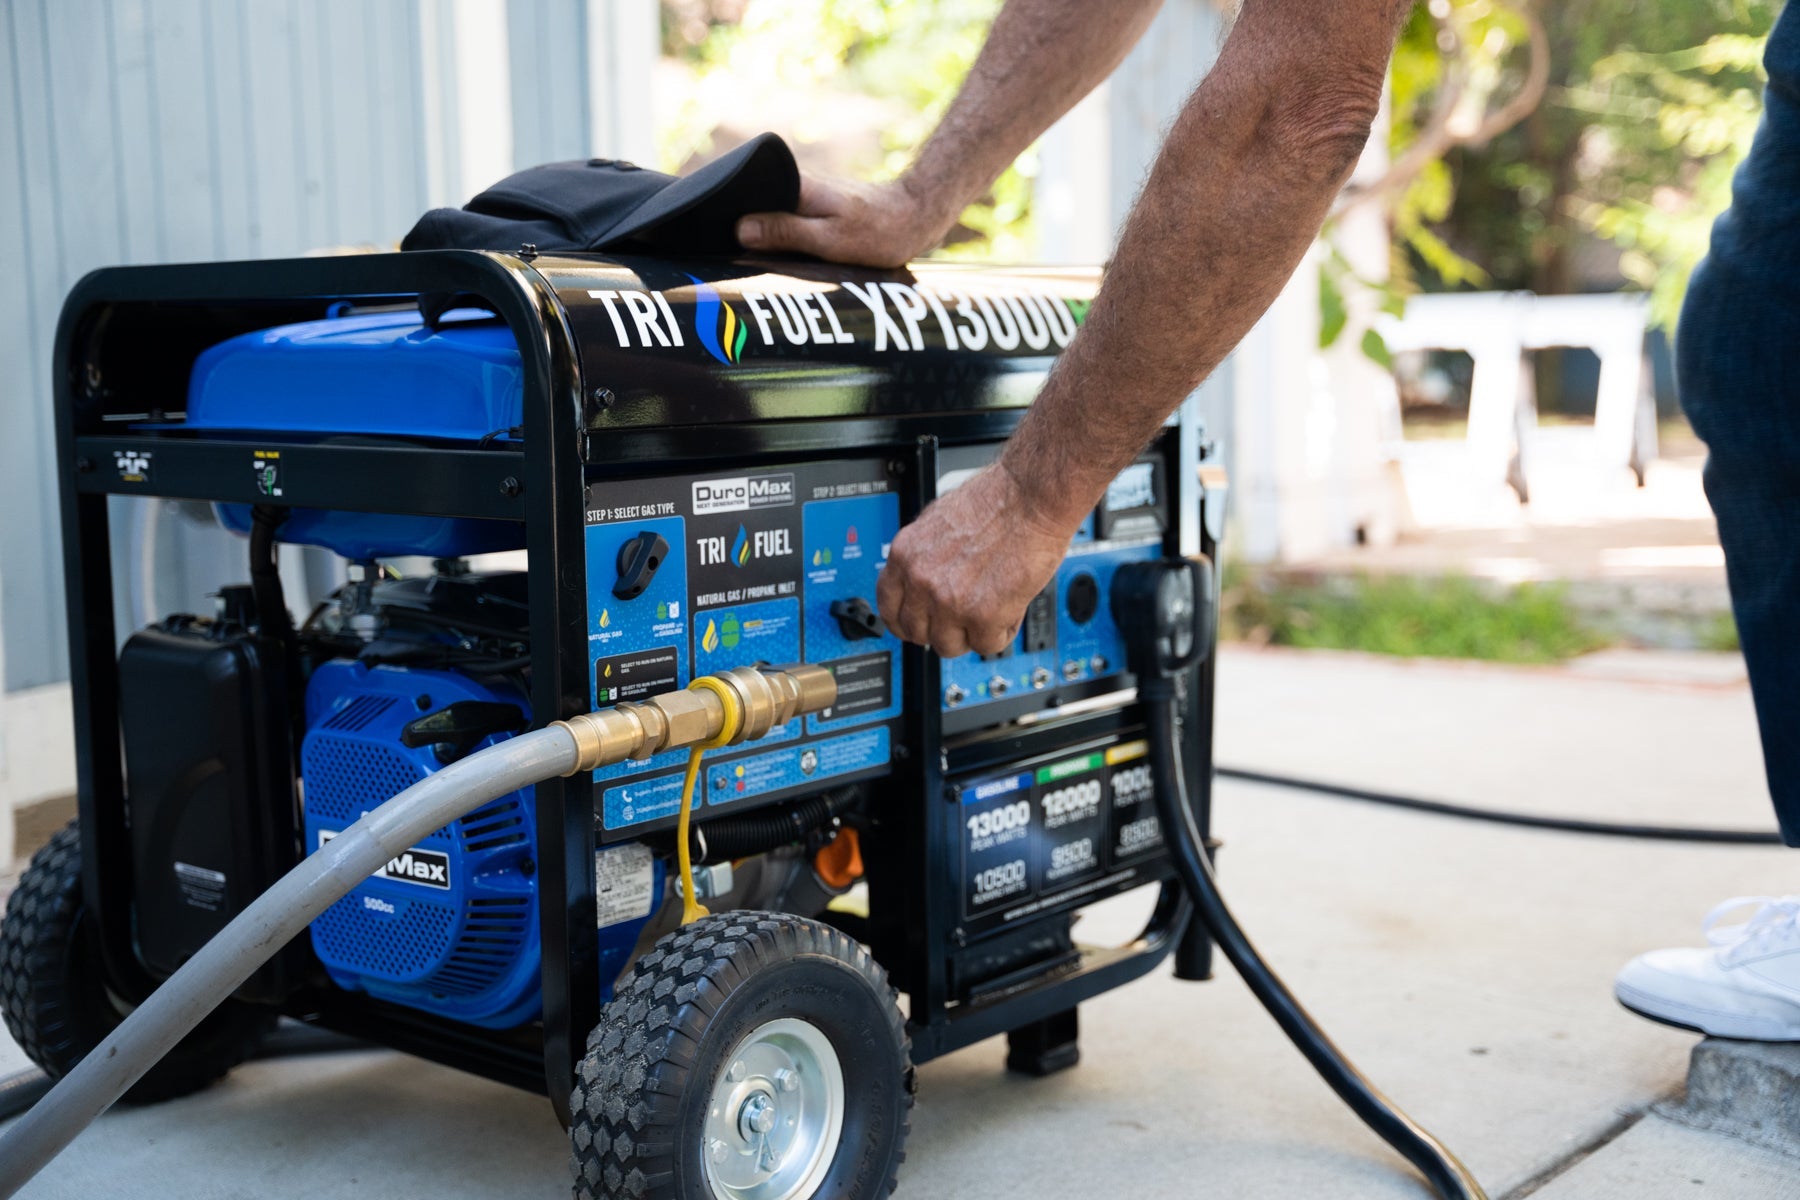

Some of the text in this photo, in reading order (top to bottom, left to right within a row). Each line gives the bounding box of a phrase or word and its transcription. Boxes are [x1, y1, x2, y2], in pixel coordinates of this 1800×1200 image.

[587, 290, 684, 347] TRI
[744, 290, 855, 346] FUEL
[587, 502, 674, 522] STEP 1: SELECT GAS TYPE
[697, 528, 793, 566] TRI FUEL
[696, 581, 796, 606] NATURAL GAS / PROPANE INLET
[612, 630, 622, 638] GAS
[1042, 779, 1101, 816] 12000
[967, 800, 1031, 840] 13000
[974, 859, 1026, 893] 10500
[364, 896, 394, 914] 500cc
